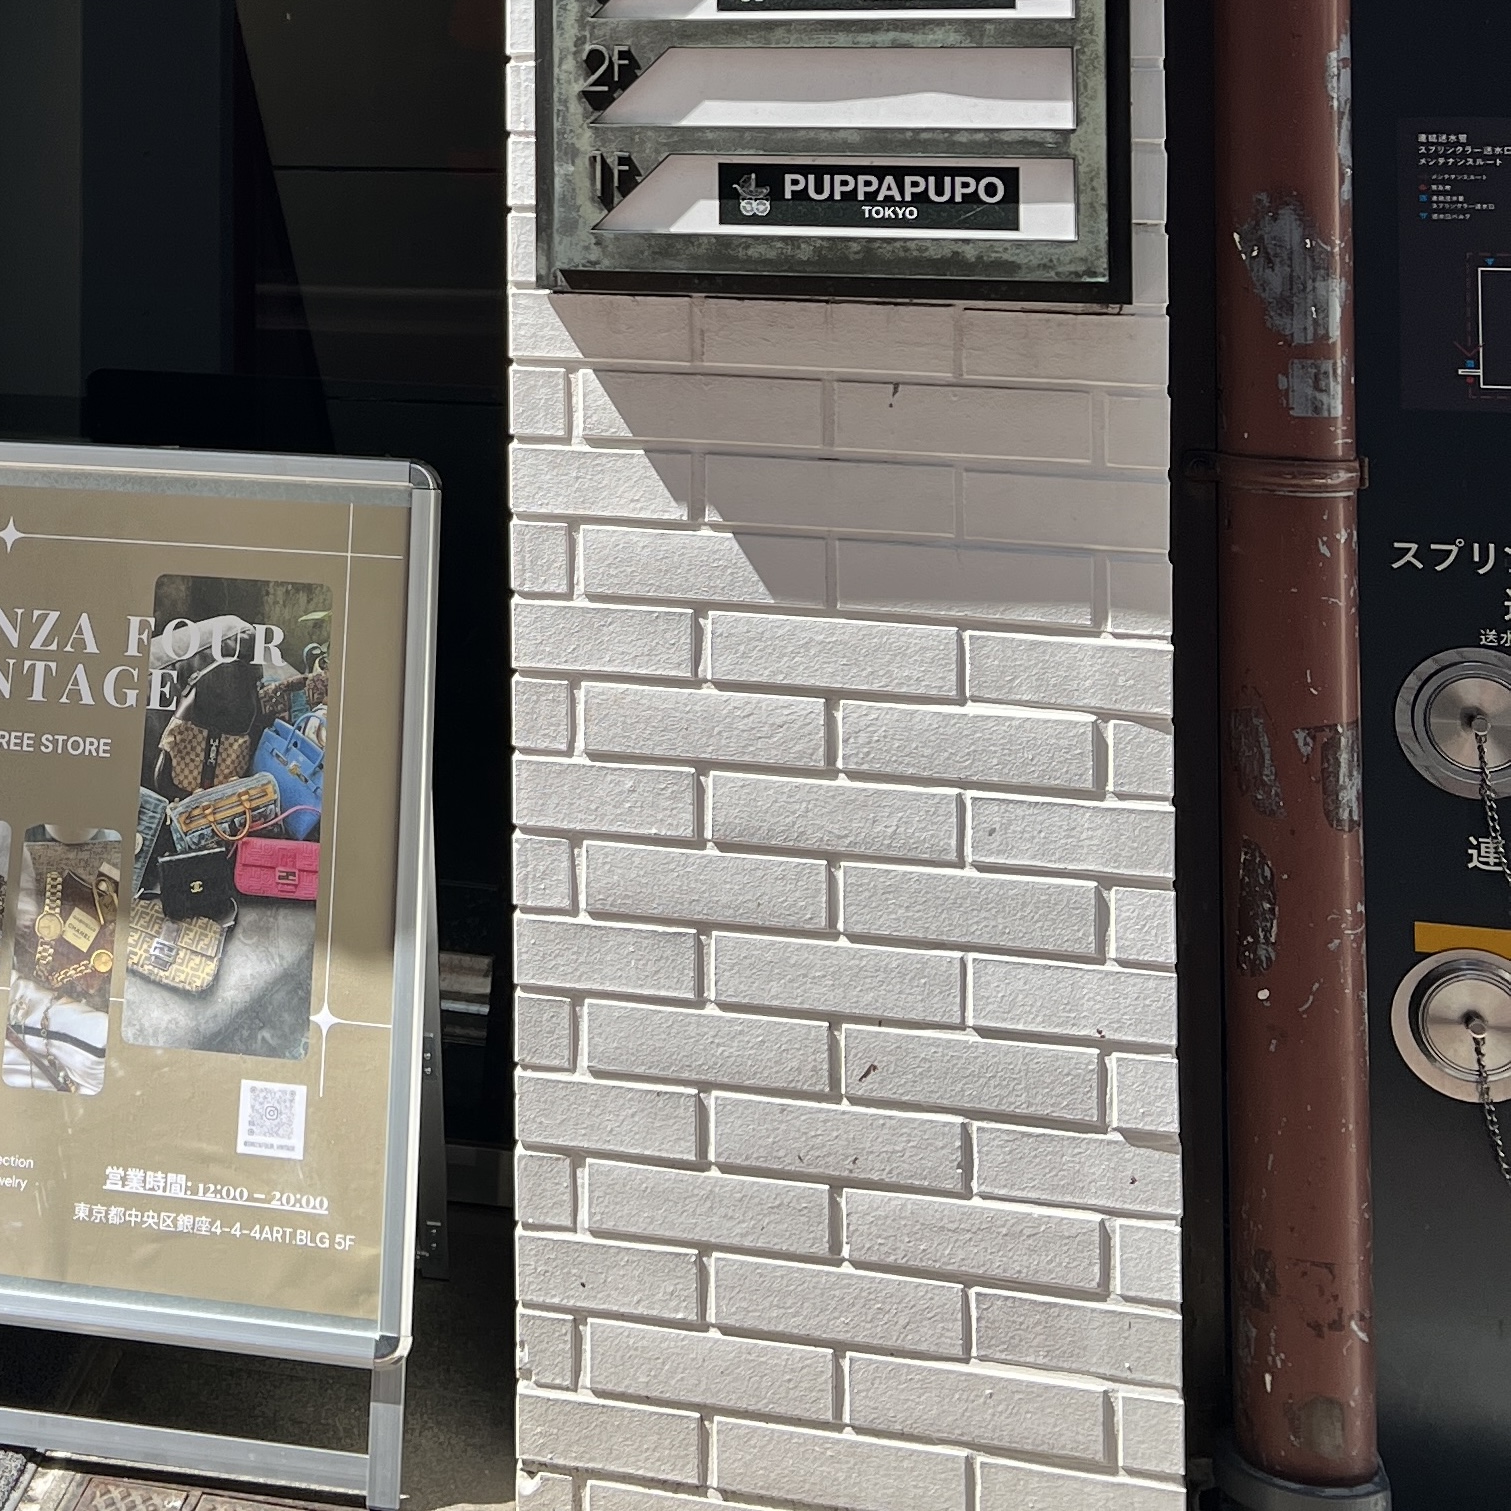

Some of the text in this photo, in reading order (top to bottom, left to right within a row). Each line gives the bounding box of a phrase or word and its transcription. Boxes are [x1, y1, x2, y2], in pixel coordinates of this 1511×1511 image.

[582, 44, 629, 91] 2F
[591, 150, 630, 197] 1F
[784, 174, 1005, 204] PUPPAPUPO
[862, 206, 918, 220] TOKYO
[124, 615, 286, 667] FOUR
[40, 734, 112, 758] STORE
[197, 1183, 248, 1203] 12:00
[270, 1191, 329, 1211] 20:00
[334, 1233, 356, 1251] 5F
